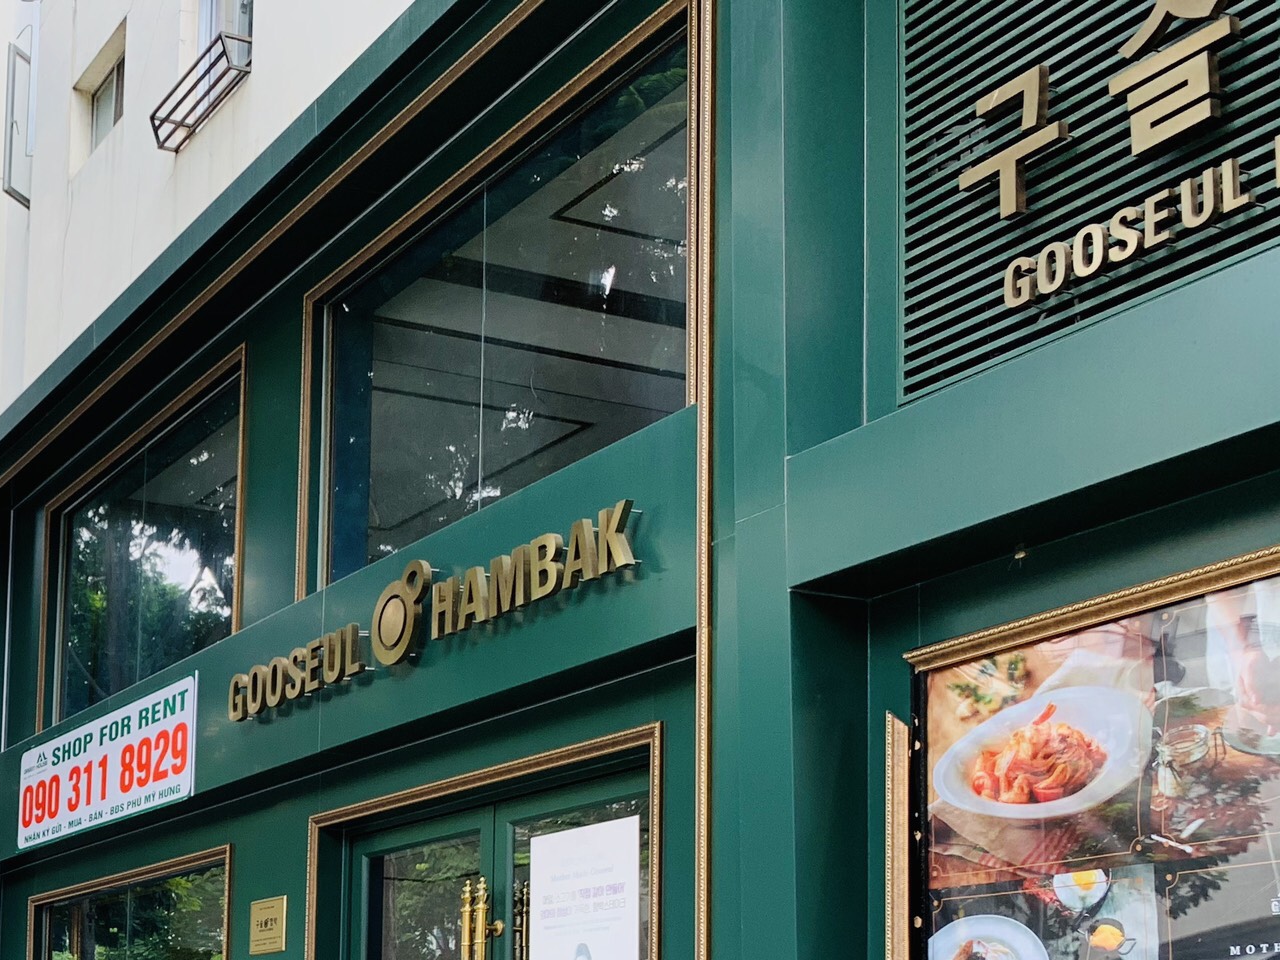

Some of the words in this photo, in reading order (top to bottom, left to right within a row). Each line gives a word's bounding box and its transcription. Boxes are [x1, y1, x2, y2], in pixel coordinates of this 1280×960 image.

[1004, 158, 1253, 308] GOOSEUL
[228, 622, 366, 722] GOOSEUL
[431, 499, 636, 640] HAMBAK
[21, 774, 61, 829] 090
[67, 754, 109, 812] 311
[119, 721, 189, 794] 8929
[51, 731, 94, 766] SHOP
[99, 715, 131, 746] FOR
[138, 688, 189, 730] RENT
[67, 819, 83, 830] MUA
